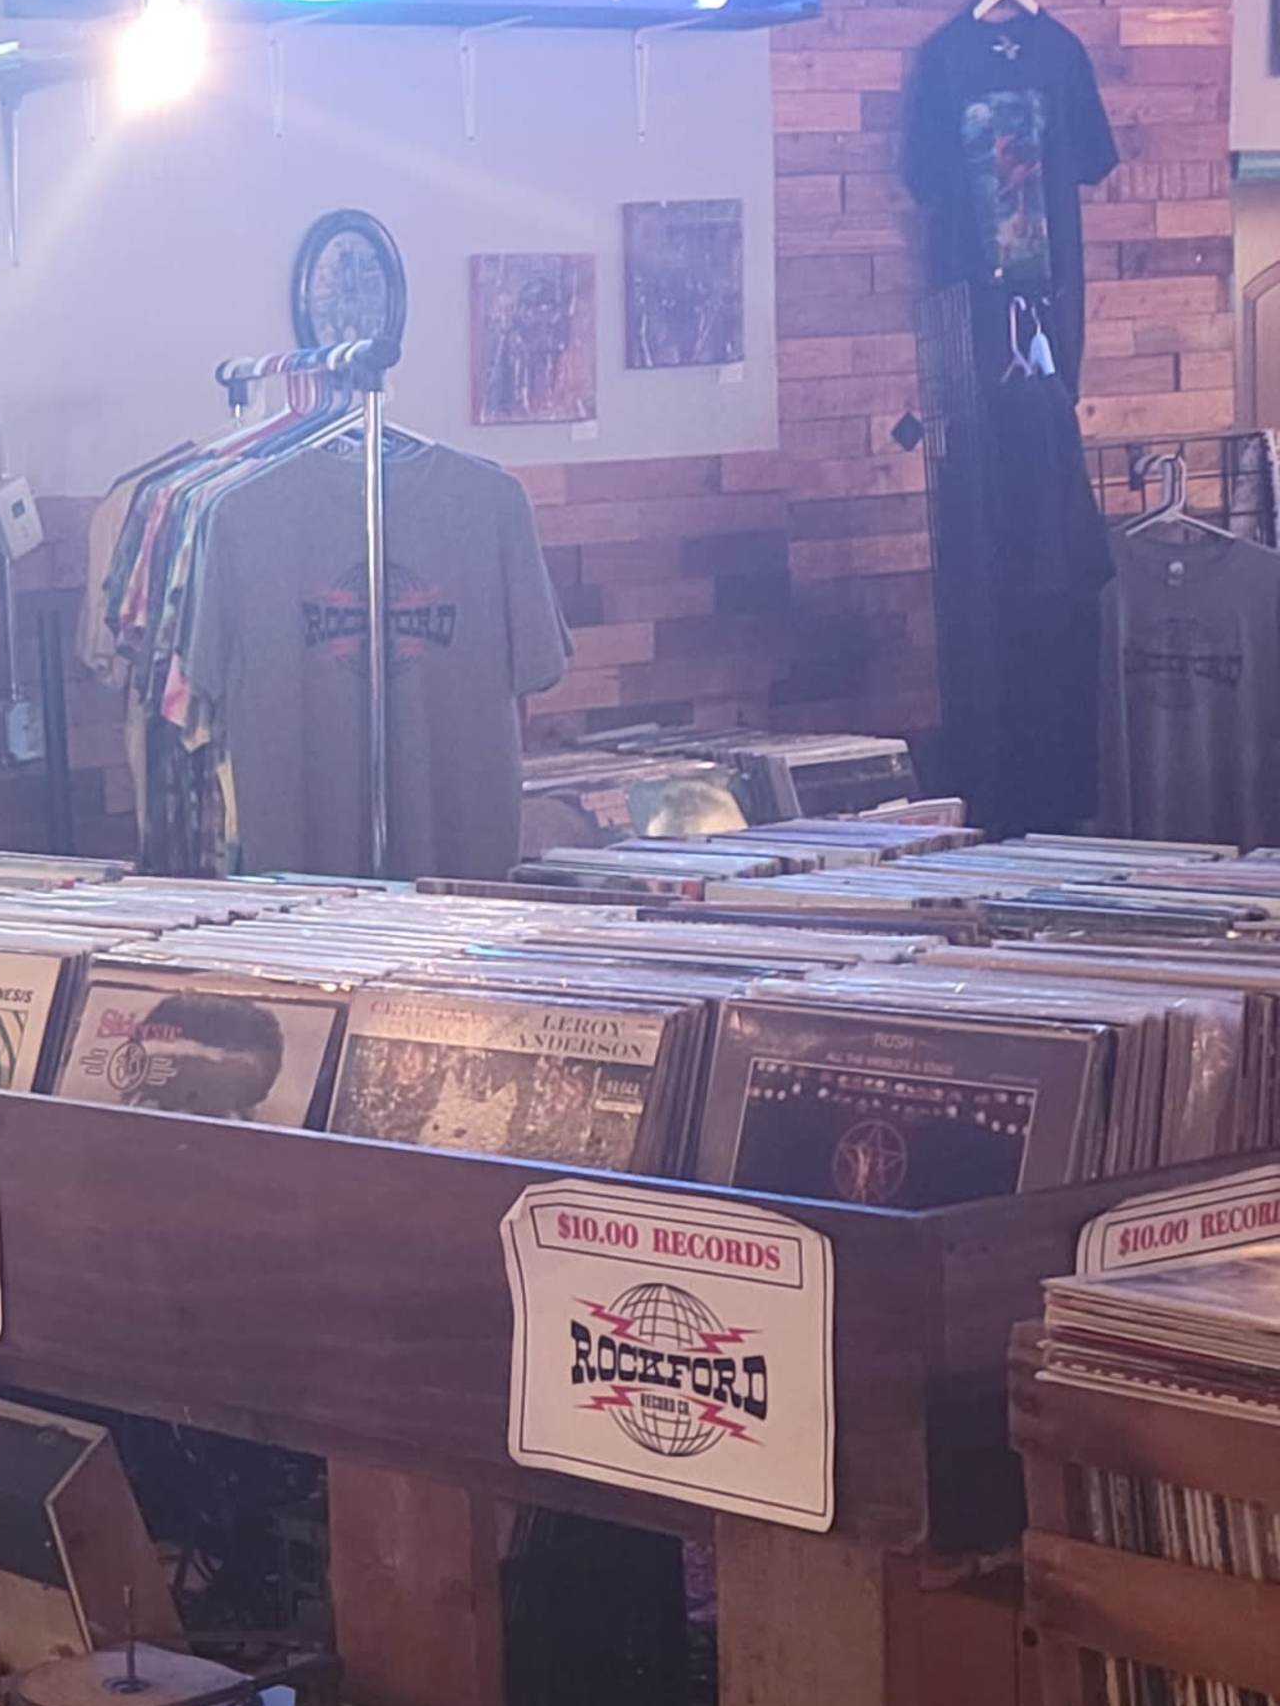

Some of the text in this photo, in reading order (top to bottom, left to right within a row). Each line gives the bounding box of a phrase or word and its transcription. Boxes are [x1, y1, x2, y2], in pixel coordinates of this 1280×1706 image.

[301, 603, 457, 649] ROCORD
[543, 1013, 624, 1038] LEROY
[513, 1033, 644, 1059] ANDERSON
[557, 1212, 781, 1271] $10.00 RECORDS
[1118, 1218, 1189, 1257] $10.00
[570, 1319, 768, 1420] ROCKFORD
[640, 1393, 675, 1414] RECORD
